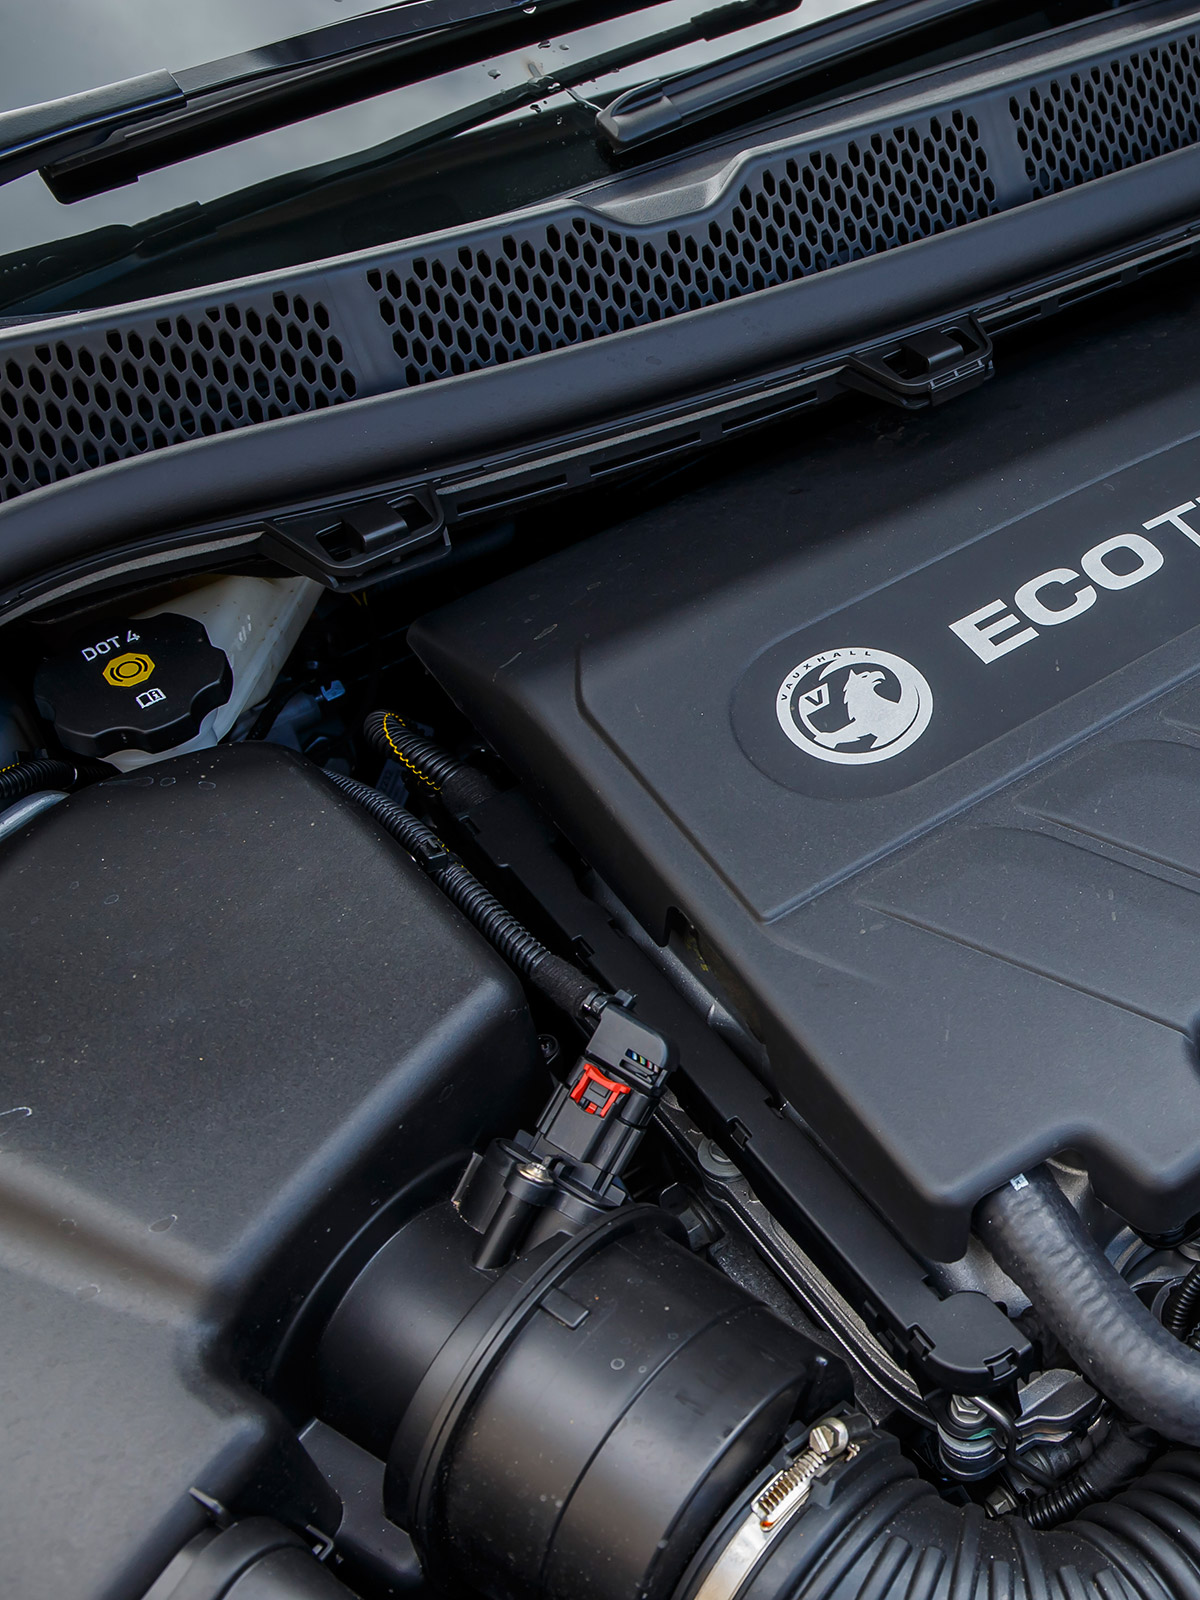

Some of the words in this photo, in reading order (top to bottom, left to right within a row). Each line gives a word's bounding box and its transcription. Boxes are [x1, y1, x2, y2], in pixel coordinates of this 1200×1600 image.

[81, 635, 121, 662] DOT
[126, 630, 141, 643] 4
[781, 650, 872, 701] VAUXHALL
